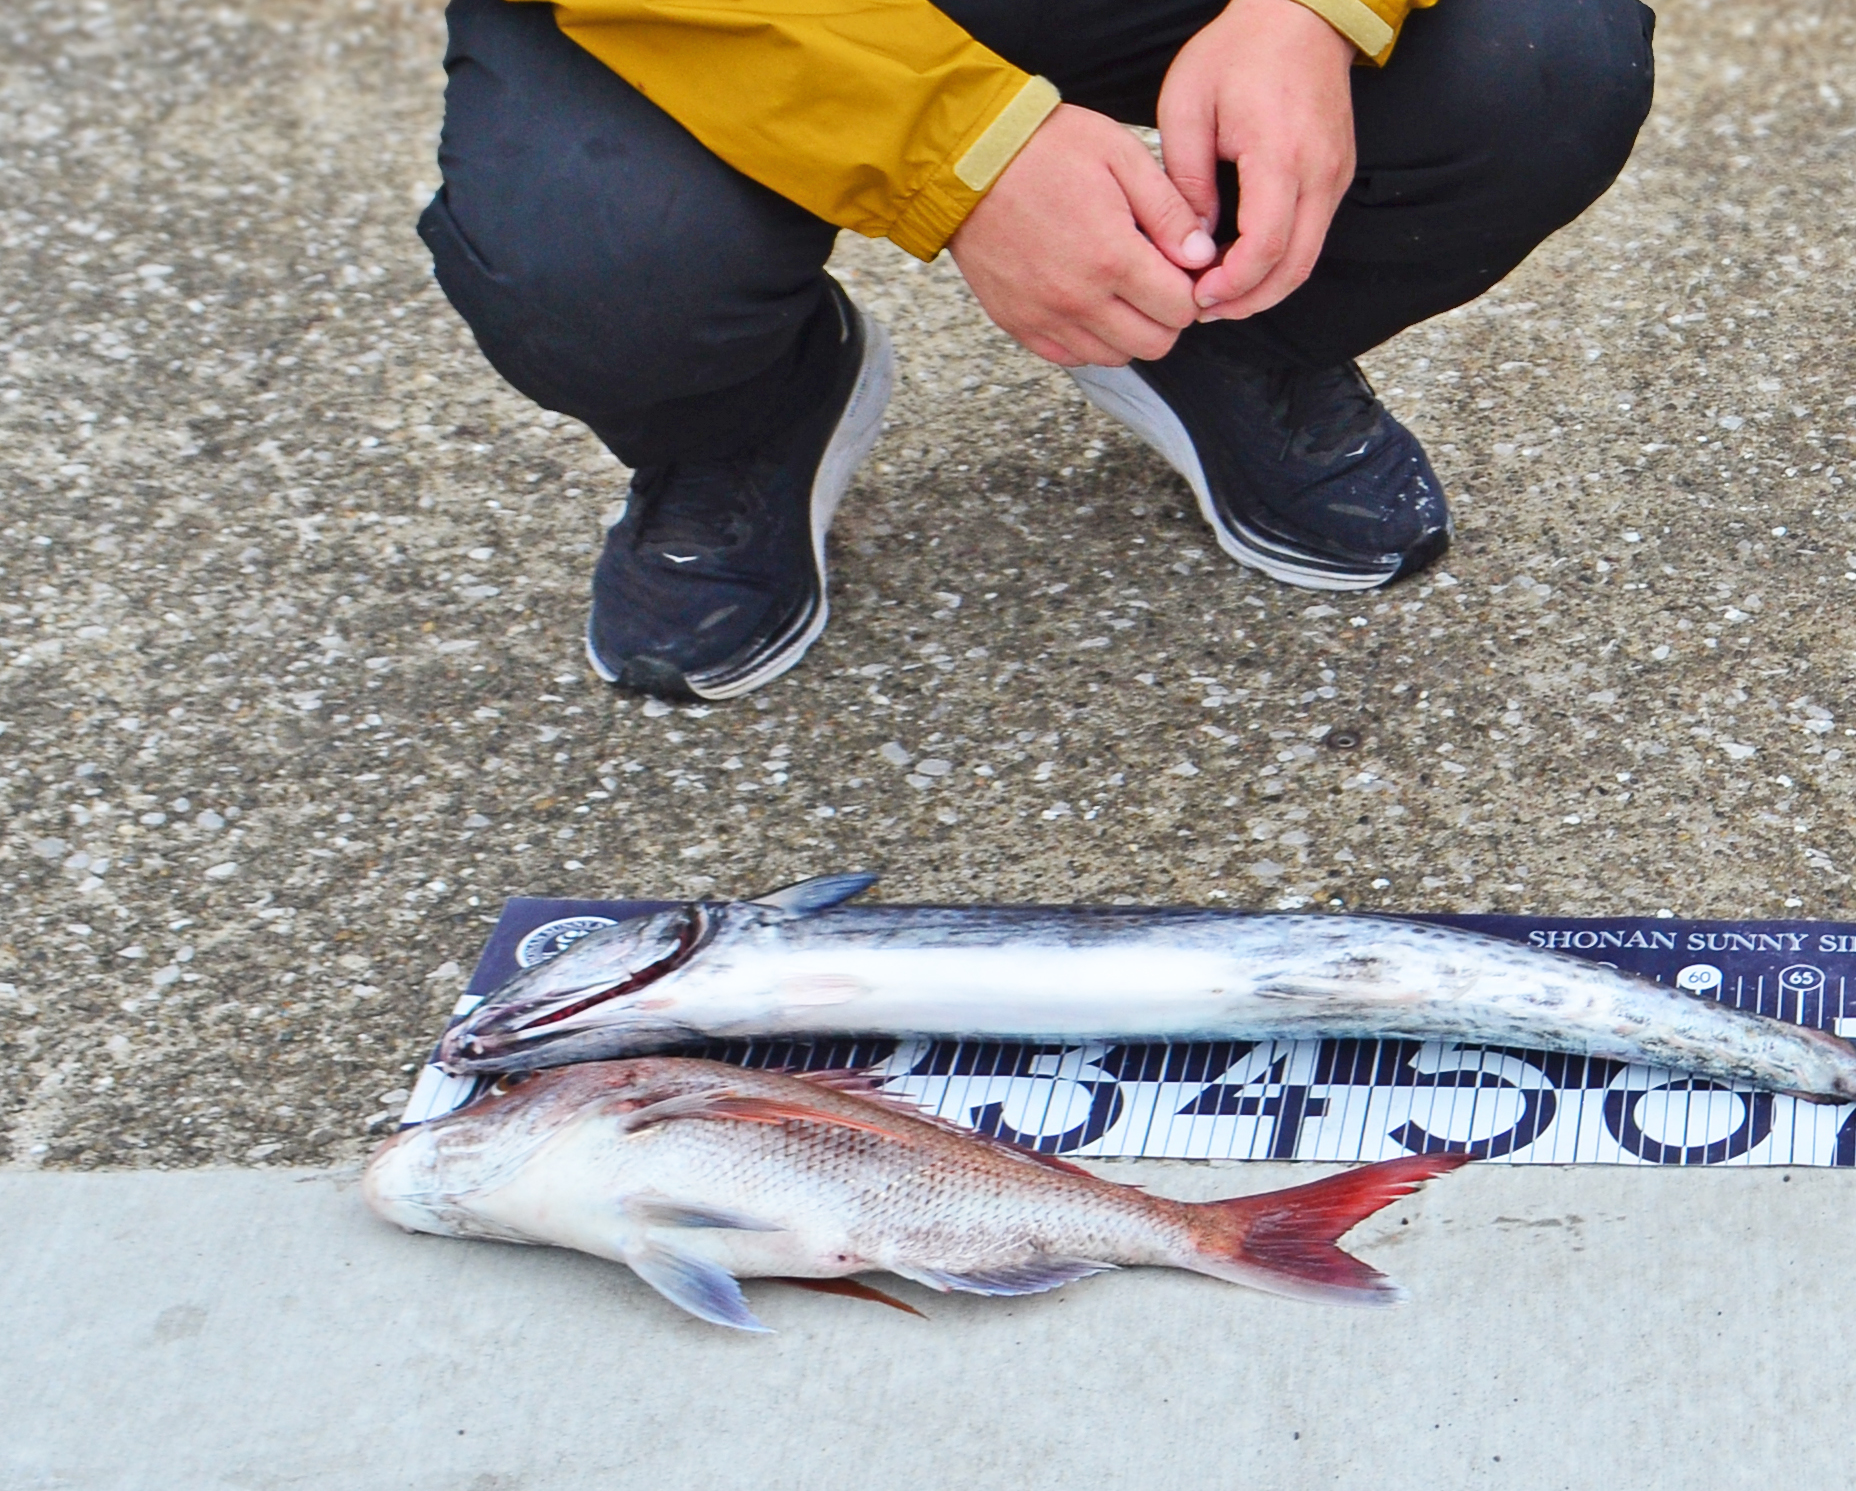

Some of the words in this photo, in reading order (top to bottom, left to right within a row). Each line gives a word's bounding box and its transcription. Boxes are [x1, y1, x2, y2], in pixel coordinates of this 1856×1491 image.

[1527, 930, 1678, 950] SHONAN
[1686, 931, 1810, 952] SUNNY
[1688, 971, 1711, 984] 60
[1789, 971, 1813, 984] 65
[1174, 1040, 1331, 1160] 4
[1388, 1040, 1557, 1161] 5
